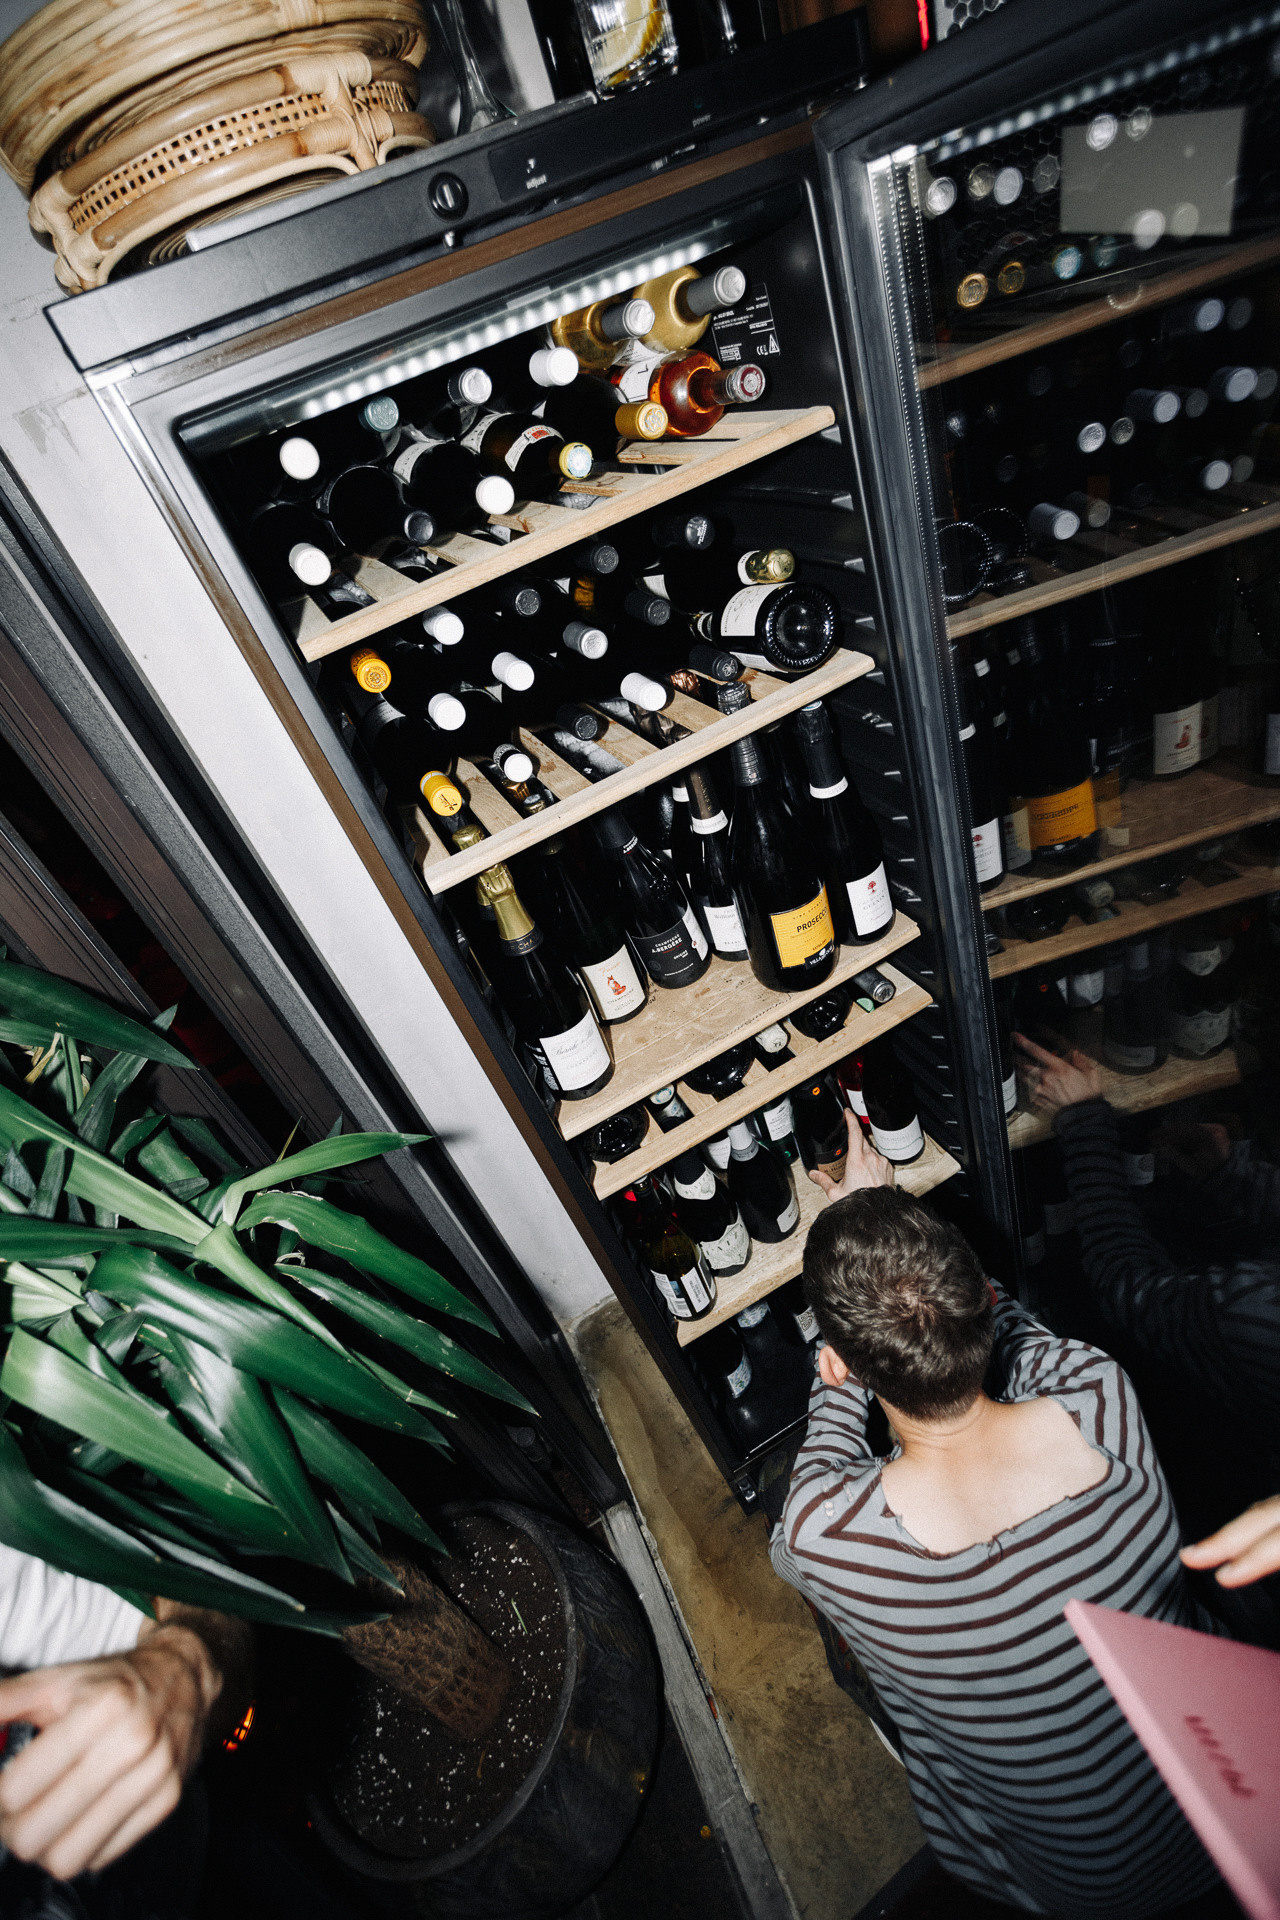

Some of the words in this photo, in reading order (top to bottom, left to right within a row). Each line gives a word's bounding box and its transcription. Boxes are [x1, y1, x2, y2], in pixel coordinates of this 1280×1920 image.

[692, 114, 711, 128] power
[526, 174, 547, 189] adjust
[796, 906, 828, 933] PROSECCO
[654, 933, 680, 948] CHAMPAGNE
